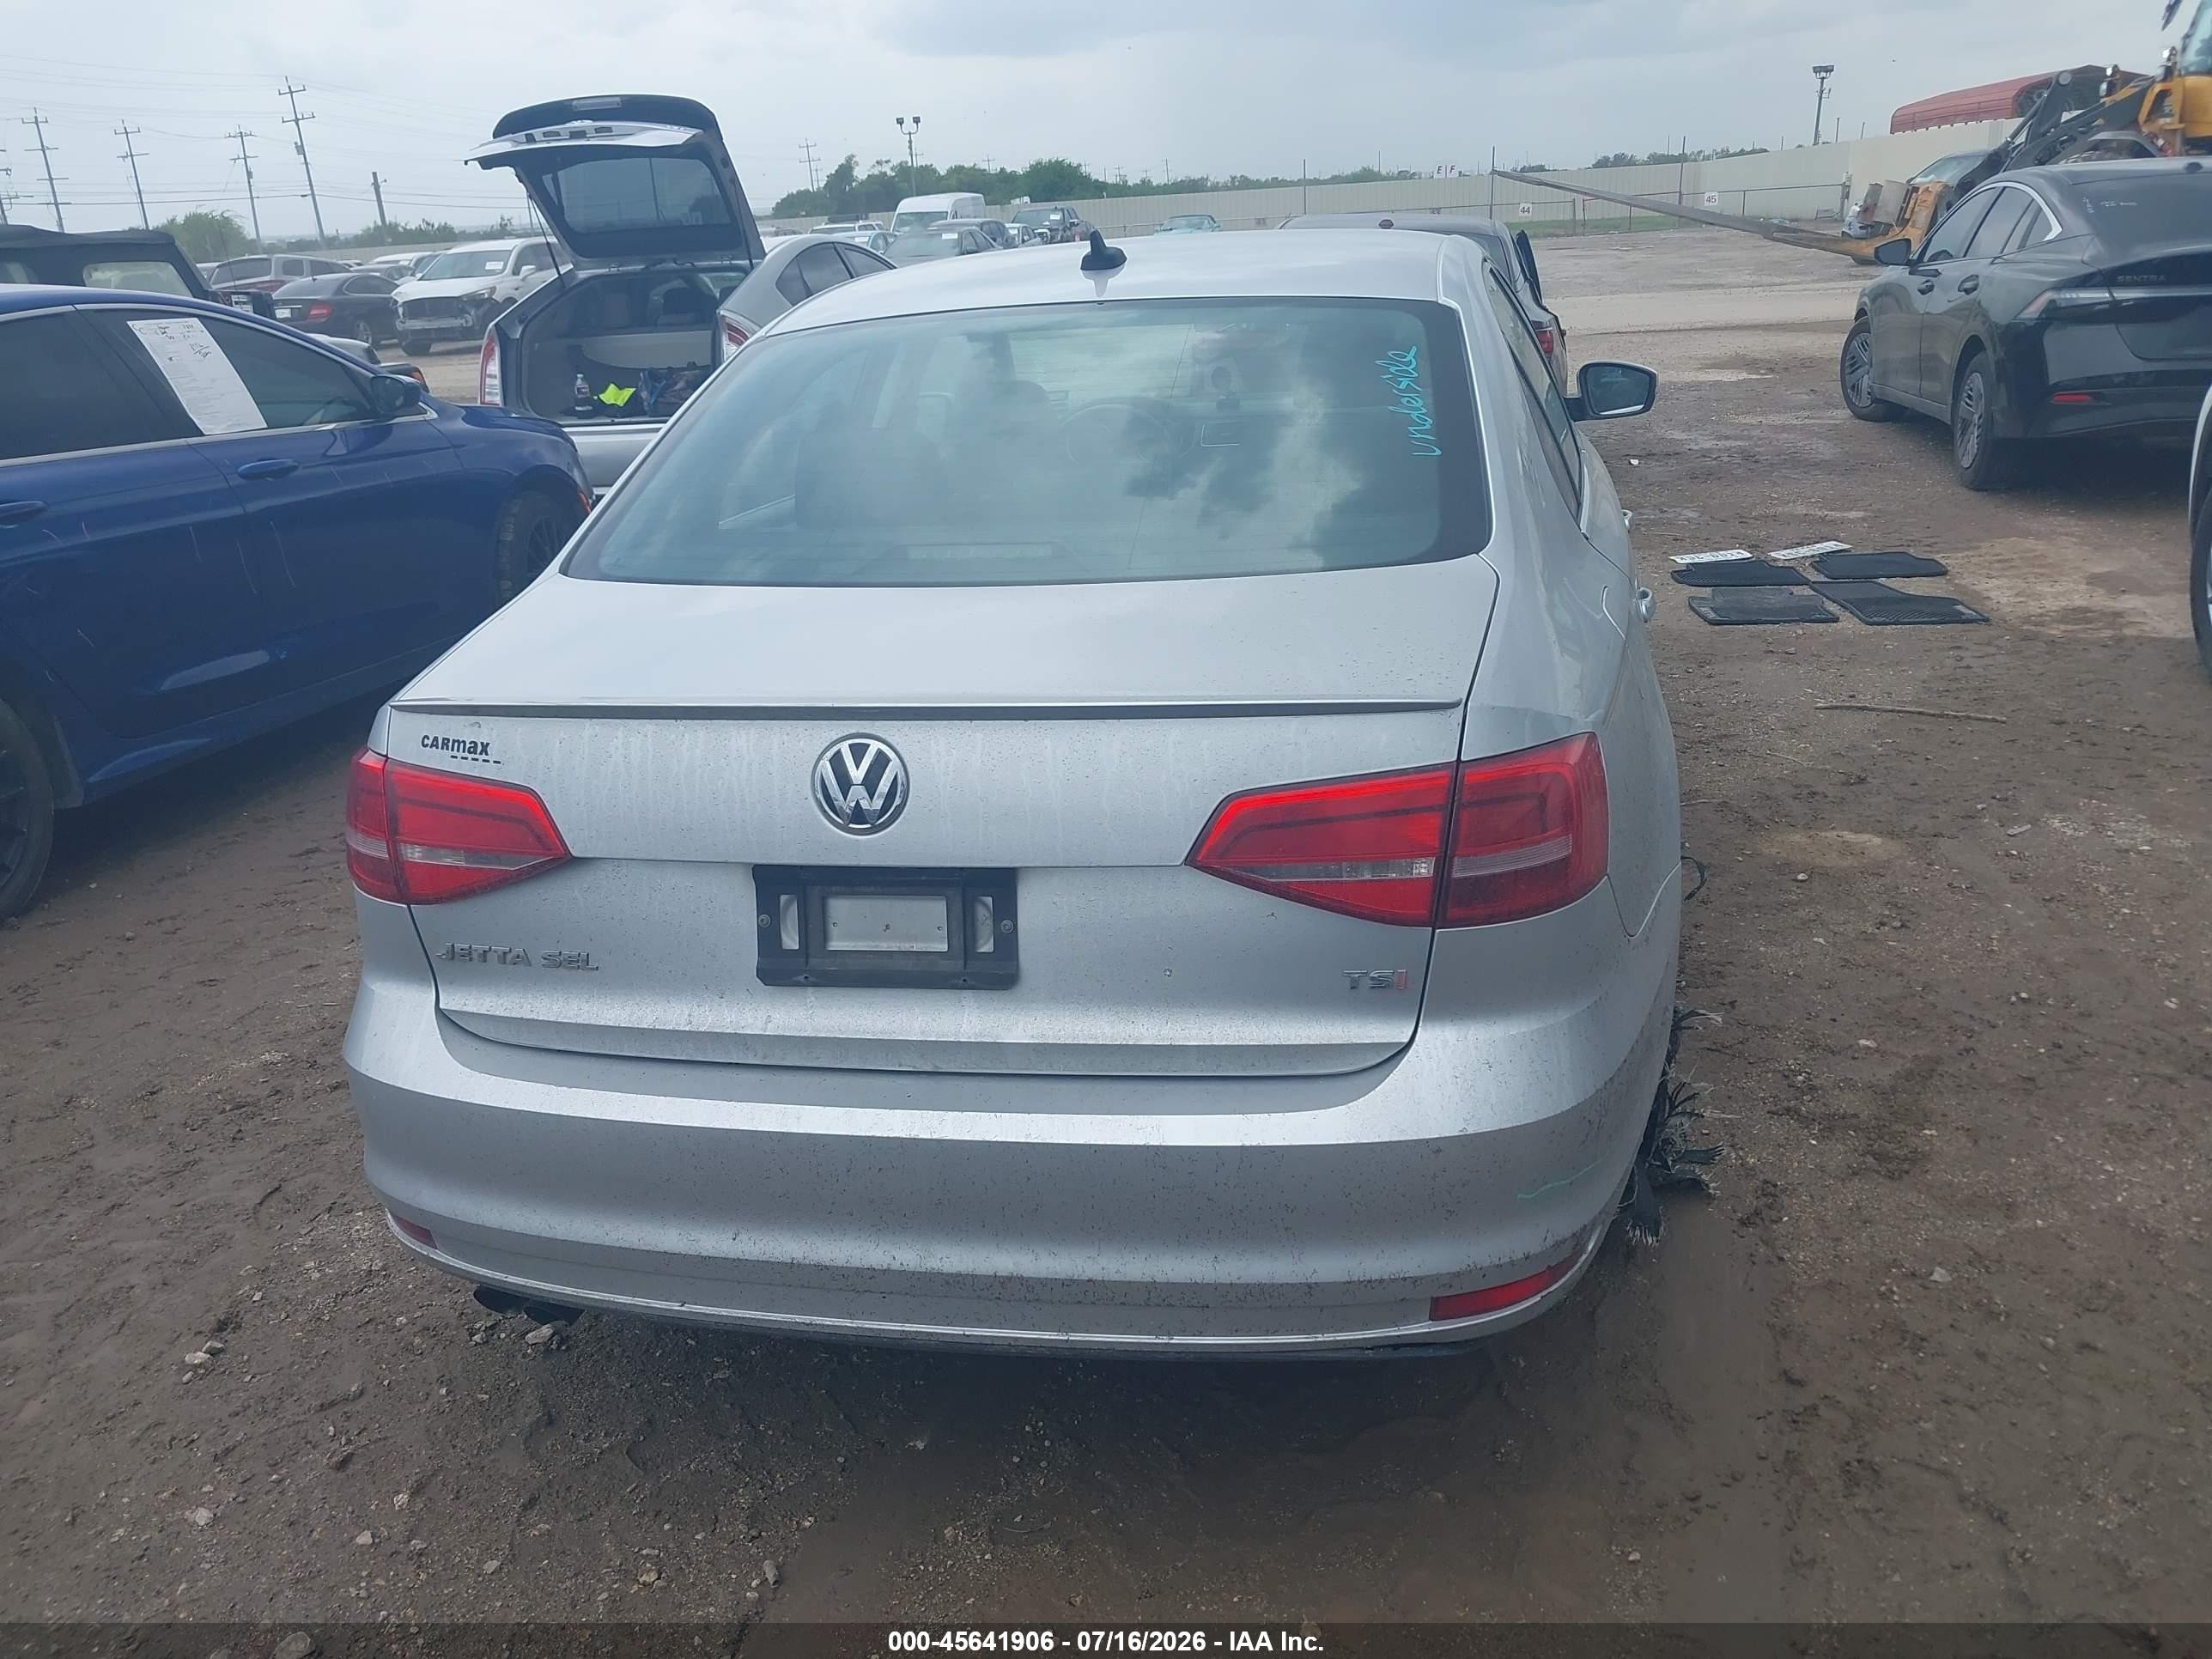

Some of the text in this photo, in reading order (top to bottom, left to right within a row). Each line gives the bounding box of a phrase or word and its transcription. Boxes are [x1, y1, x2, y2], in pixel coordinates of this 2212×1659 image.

[1437, 164, 1456, 174] E F
[1705, 194, 1717, 204] 45
[1520, 206, 1531, 215] 44
[812, 735, 908, 833] VW
[435, 942, 599, 971] JETTA SEL
